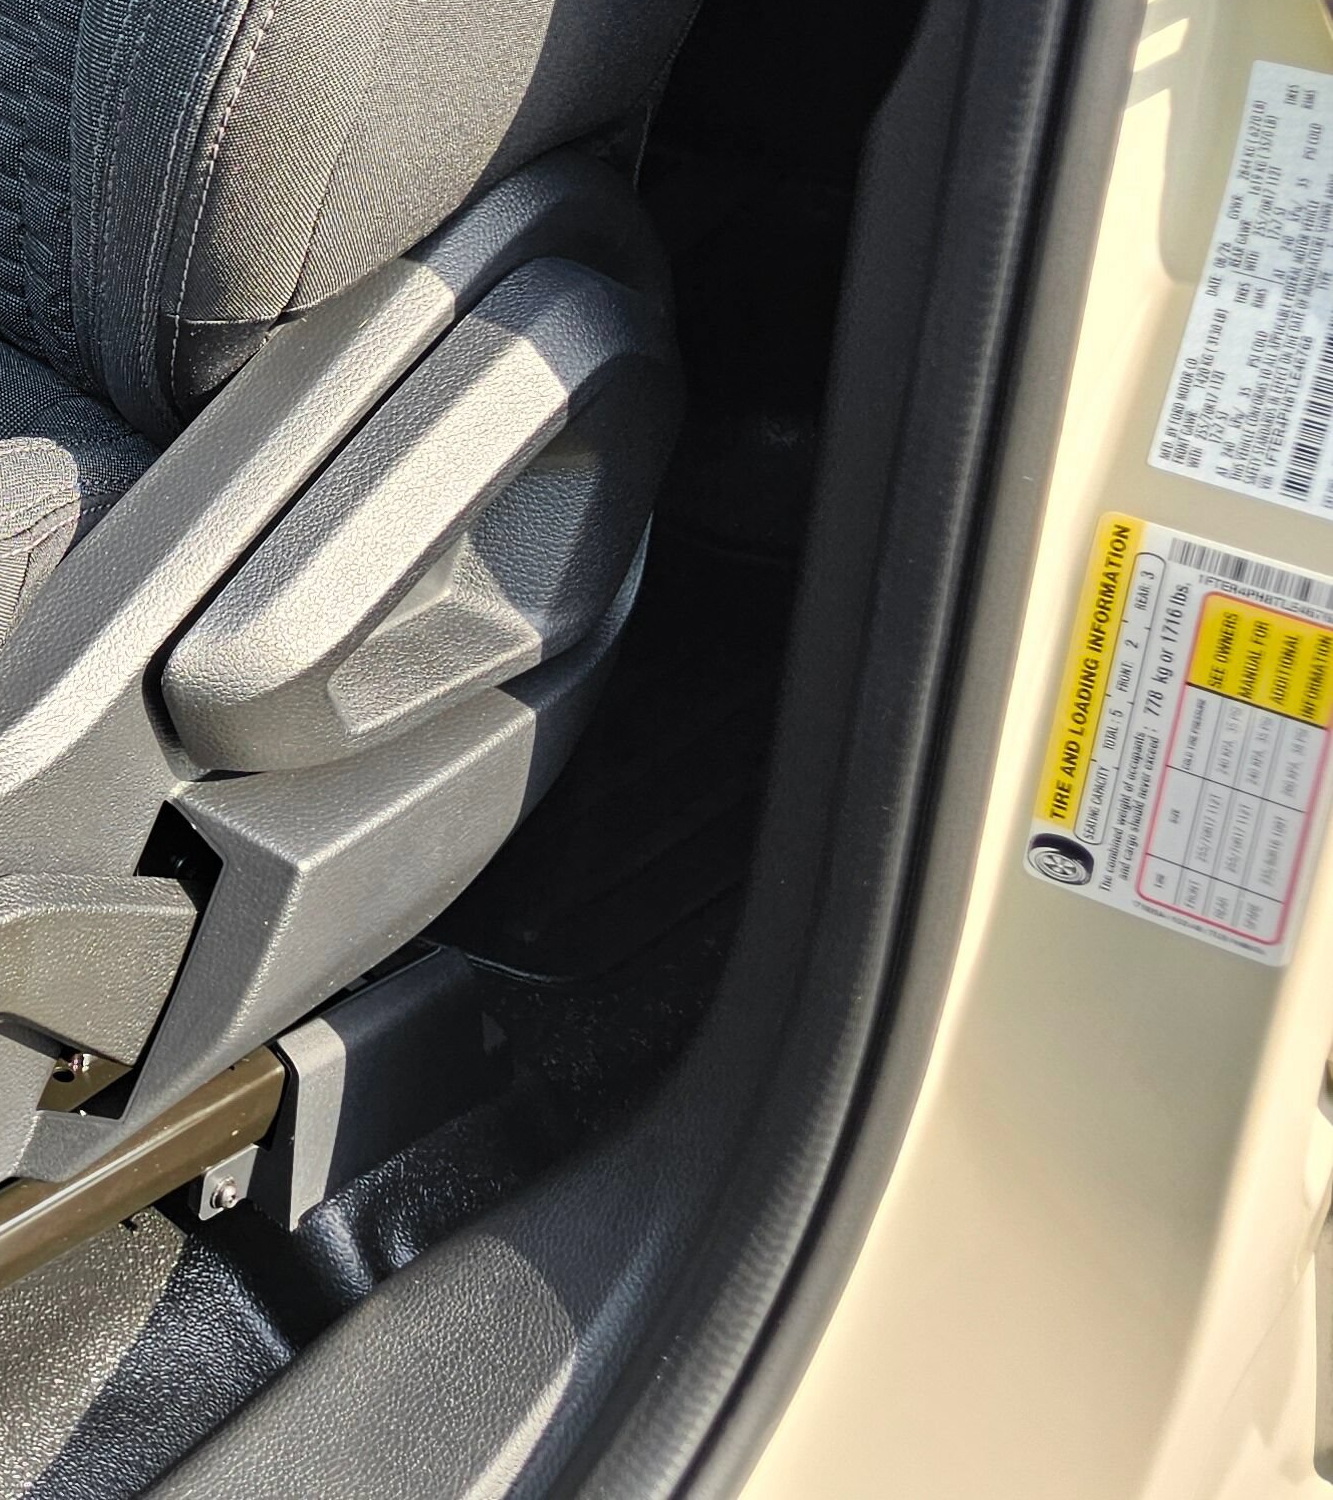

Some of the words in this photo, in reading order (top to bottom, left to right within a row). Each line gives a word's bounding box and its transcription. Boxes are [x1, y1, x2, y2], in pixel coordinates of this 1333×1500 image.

[1300, 87, 1317, 110] RIMS
[1242, 248, 1260, 272] WITH
[1282, 82, 1300, 106] TIRES
[1299, 198, 1320, 233] VEHICLE
[1228, 245, 1245, 268] REAR
[1290, 231, 1310, 264] MOTOR
[1249, 285, 1268, 309] RIMS
[1280, 265, 1301, 301] FEDERAL
[1206, 323, 1223, 346] 3130
[1266, 301, 1291, 351] APPLICABLE
[1286, 310, 1305, 332] DATE
[1250, 328, 1269, 353] COLD
[1185, 445, 1203, 469] WITH
[1232, 279, 1251, 305] TIRES
[1200, 353, 1214, 366] KG
[1245, 352, 1261, 368] PSI
[1257, 367, 1273, 380] TO
[1261, 351, 1277, 367] ALL
[1175, 369, 1194, 401] MOTOR
[1193, 366, 1210, 390] 1420
[1269, 364, 1289, 394] EFFECT
[1168, 400, 1185, 425] FORD
[1244, 379, 1268, 427] CONFORMS
[1164, 425, 1178, 437] BY
[1234, 428, 1254, 462] VEHICLE
[1251, 404, 1277, 456] STANDARDS
[1171, 436, 1190, 465] FRONT
[1219, 439, 1236, 458] 240
[1228, 461, 1245, 482] THIS
[1242, 456, 1262, 486] SAFETY
[1085, 522, 1130, 654] INFORMATION
[1167, 577, 1192, 607] lbs.
[1123, 637, 1139, 649] 2
[1139, 568, 1155, 581] 3
[1159, 605, 1184, 644] 1716
[1212, 609, 1239, 664] OWNERS
[1248, 618, 1269, 646] FOR
[1159, 647, 1175, 664] or
[1268, 630, 1300, 706] ADDITIONAL
[1150, 663, 1173, 685] kg
[1206, 664, 1226, 690] SEE
[1236, 646, 1263, 700] MANUAL
[1296, 631, 1332, 720] INFORMATION
[1067, 655, 1100, 737] LOADING
[1142, 687, 1165, 718] 778
[1107, 706, 1124, 718] 5
[1058, 738, 1082, 778] AND
[1124, 729, 1148, 782] occupants
[1141, 734, 1160, 771] exceed
[1089, 763, 1110, 806] CAPACITY
[1121, 779, 1135, 792] of
[1136, 771, 1151, 799] never
[1048, 779, 1073, 822] TIRE
[1113, 792, 1134, 827] weight
[1081, 804, 1101, 841] SEATING
[1127, 799, 1145, 833] should
[1102, 825, 1124, 874] combined
[1122, 832, 1139, 862] cargo
[1098, 873, 1113, 893] The
[1116, 860, 1131, 881] and
